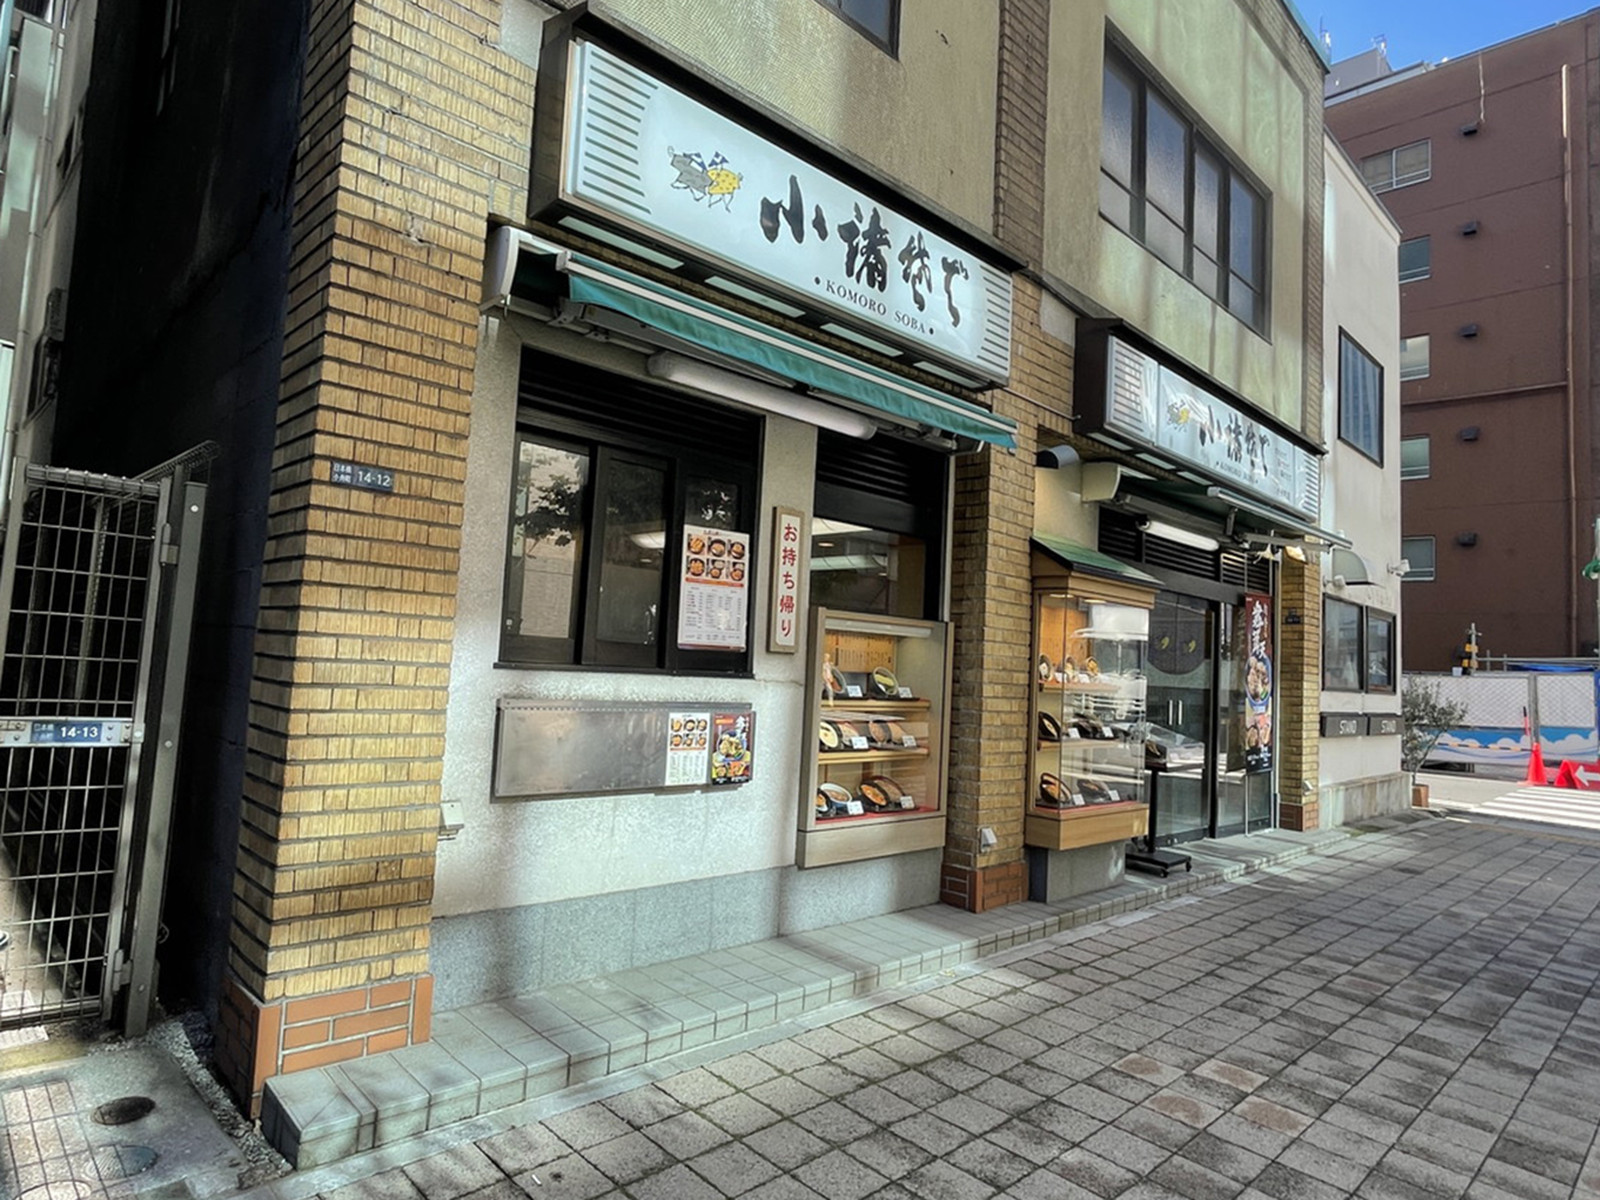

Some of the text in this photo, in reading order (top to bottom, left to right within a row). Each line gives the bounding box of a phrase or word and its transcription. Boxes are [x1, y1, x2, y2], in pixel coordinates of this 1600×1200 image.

[825, 279, 926, 335] KOMORO SOBA
[358, 470, 391, 487] 14-12
[780, 523, 798, 637] お持ち帰り
[61, 727, 98, 738] 14-13
